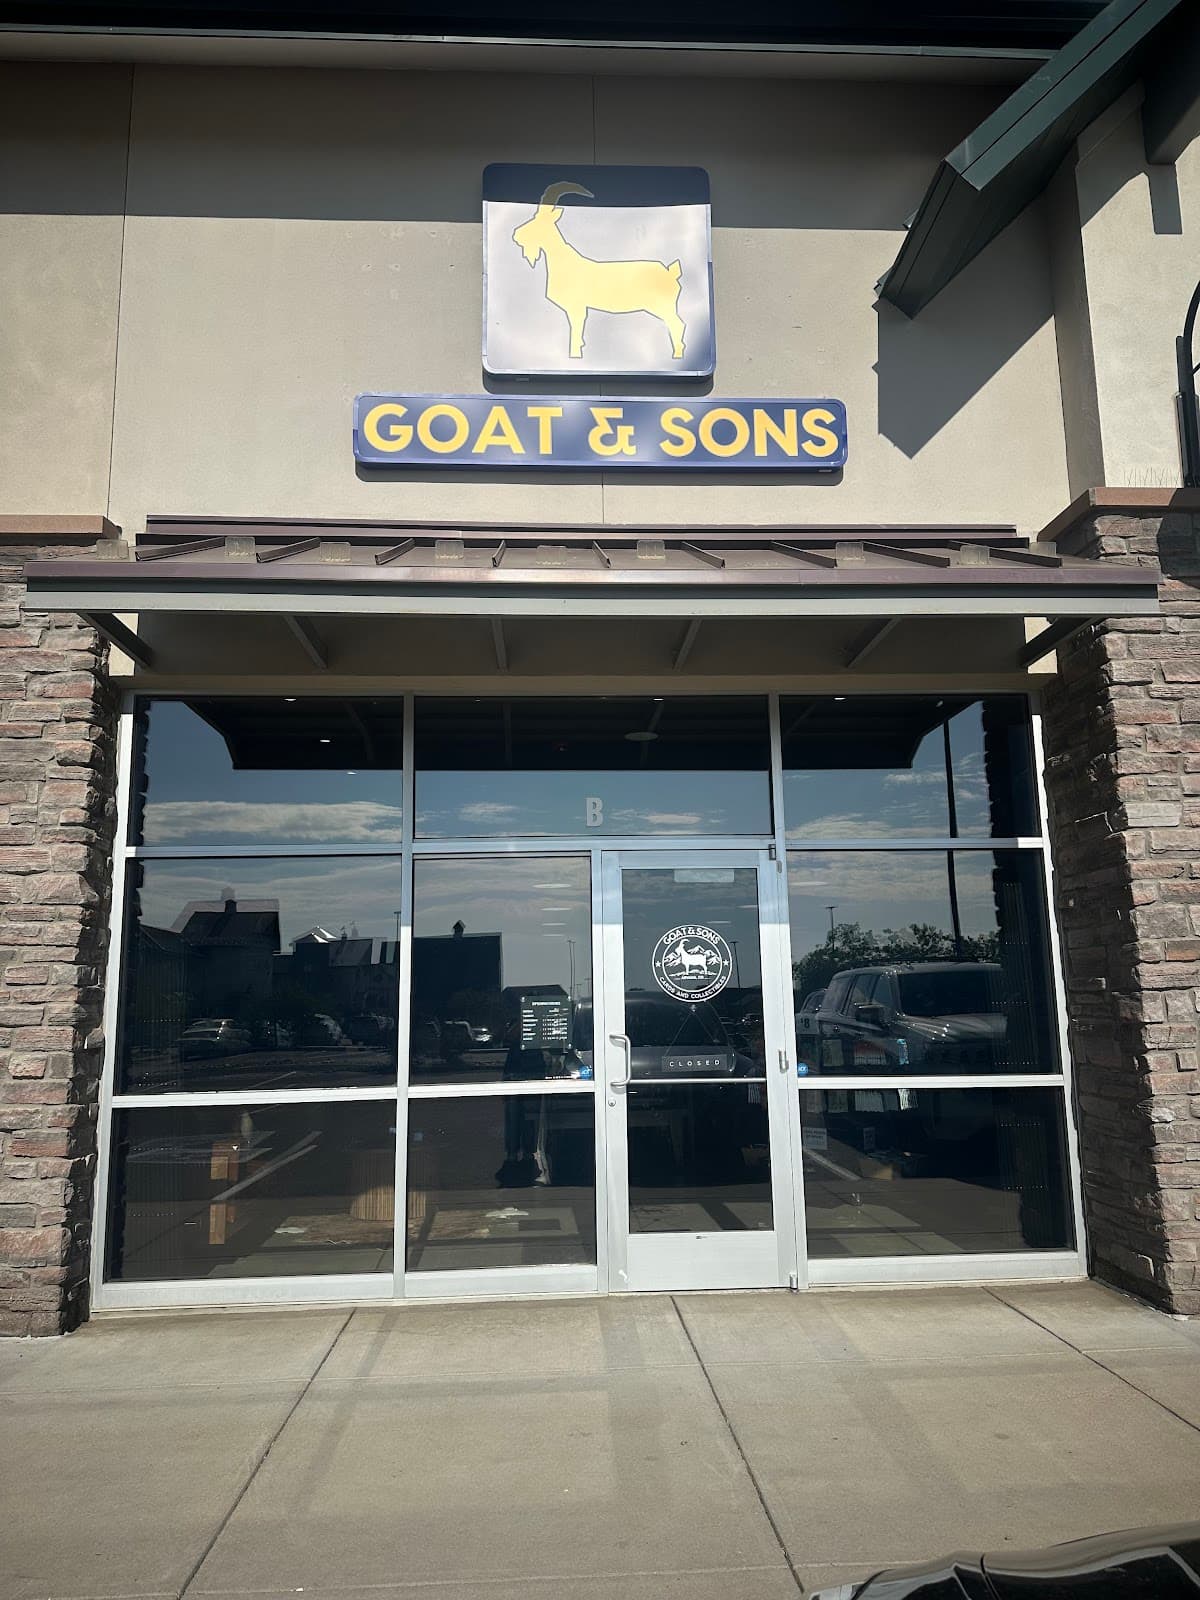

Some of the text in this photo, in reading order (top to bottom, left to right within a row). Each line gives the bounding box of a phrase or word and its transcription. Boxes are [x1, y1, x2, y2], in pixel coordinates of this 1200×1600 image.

[363, 403, 839, 458] GOAT & SONS
[586, 797, 603, 827] B
[663, 926, 721, 945] GOAT & SONS
[659, 976, 676, 994] CARDS
[676, 991, 689, 999] AND
[669, 1059, 720, 1067] CLOSED
